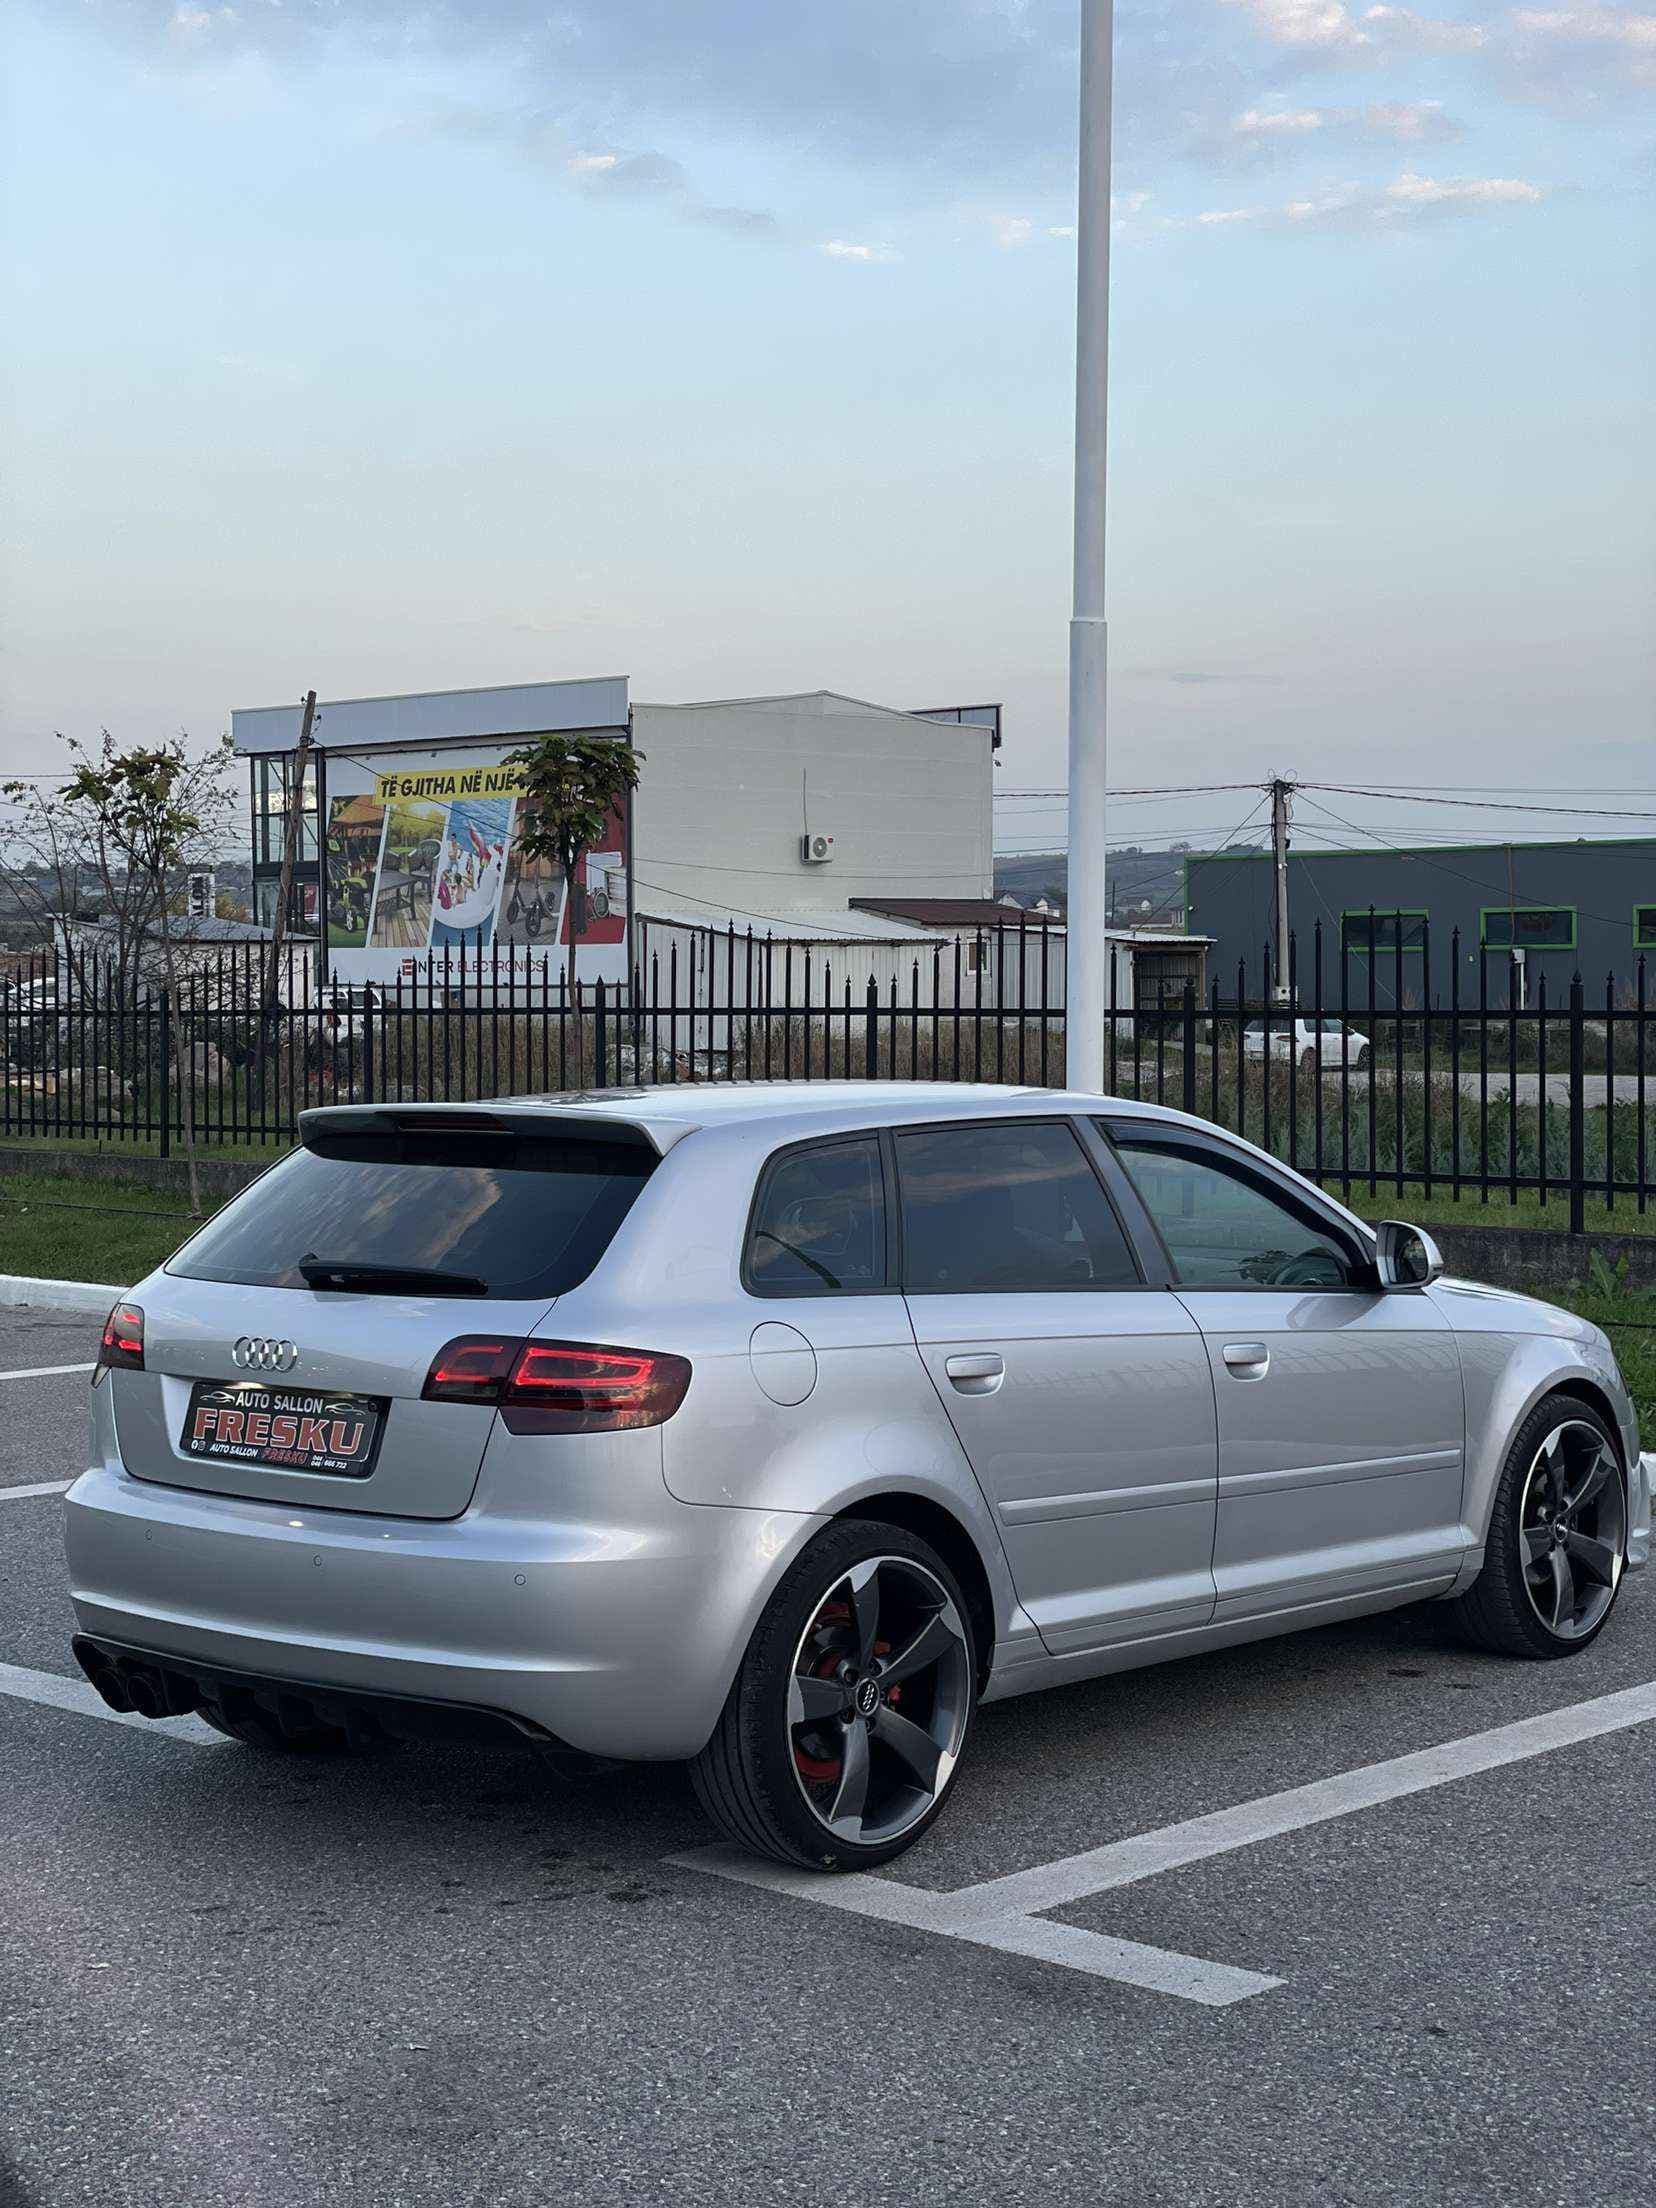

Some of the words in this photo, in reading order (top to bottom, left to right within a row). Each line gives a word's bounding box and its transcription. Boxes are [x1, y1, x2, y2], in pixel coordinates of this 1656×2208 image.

[381, 776, 398, 798] TË
[400, 775, 456, 797] GJITHA
[460, 770, 482, 793] NË
[485, 768, 514, 792] NJË
[235, 1391, 270, 1409] AUTO
[273, 1395, 324, 1414] SALLON
[193, 1407, 364, 1455] FRESKU
[209, 1443, 230, 1454] AUTO
[229, 1446, 259, 1458] SALLON
